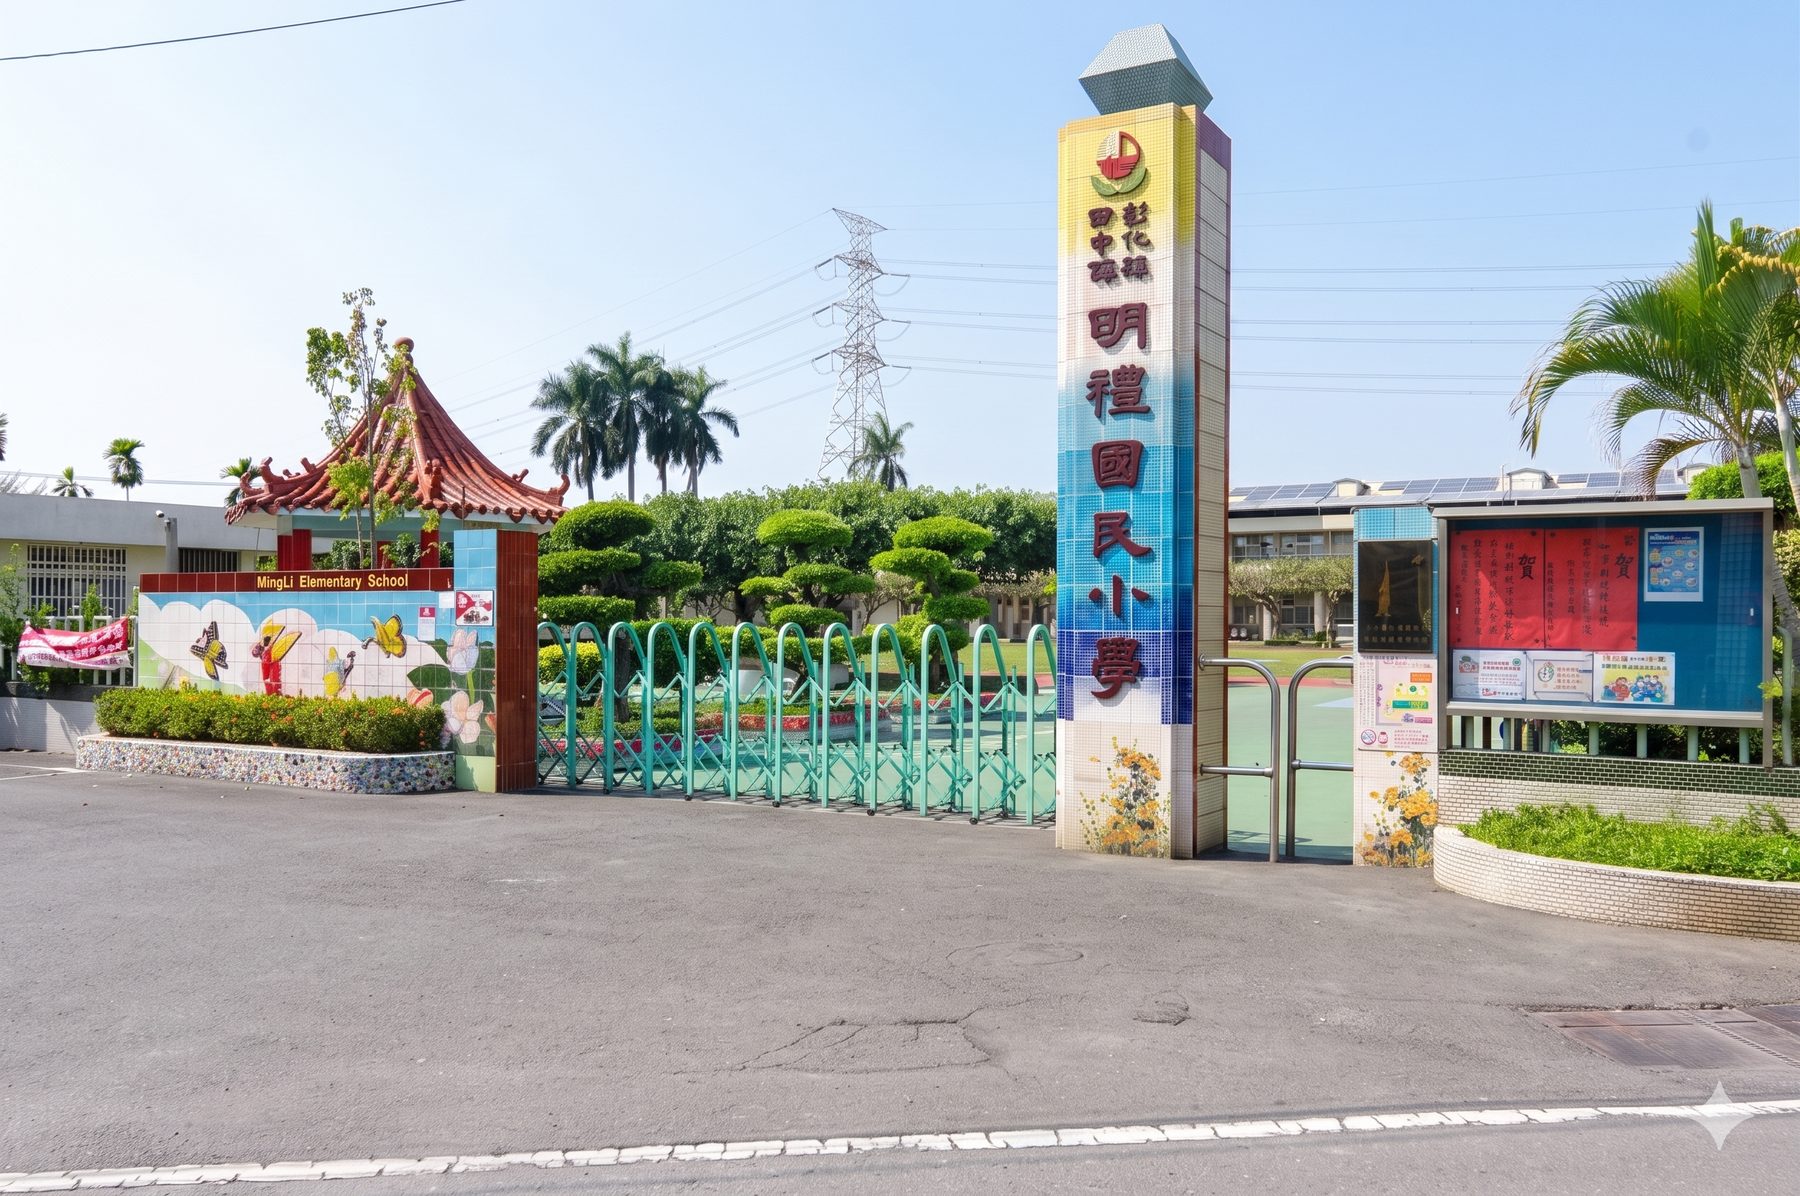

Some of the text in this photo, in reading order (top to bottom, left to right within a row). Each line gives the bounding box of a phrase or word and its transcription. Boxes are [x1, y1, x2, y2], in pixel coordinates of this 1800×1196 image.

[1086, 302, 1153, 699] 明禮國民小學
[1518, 553, 1536, 580] 賀
[1615, 552, 1634, 580] 賀
[257, 573, 408, 591] MingLi Elementary School
